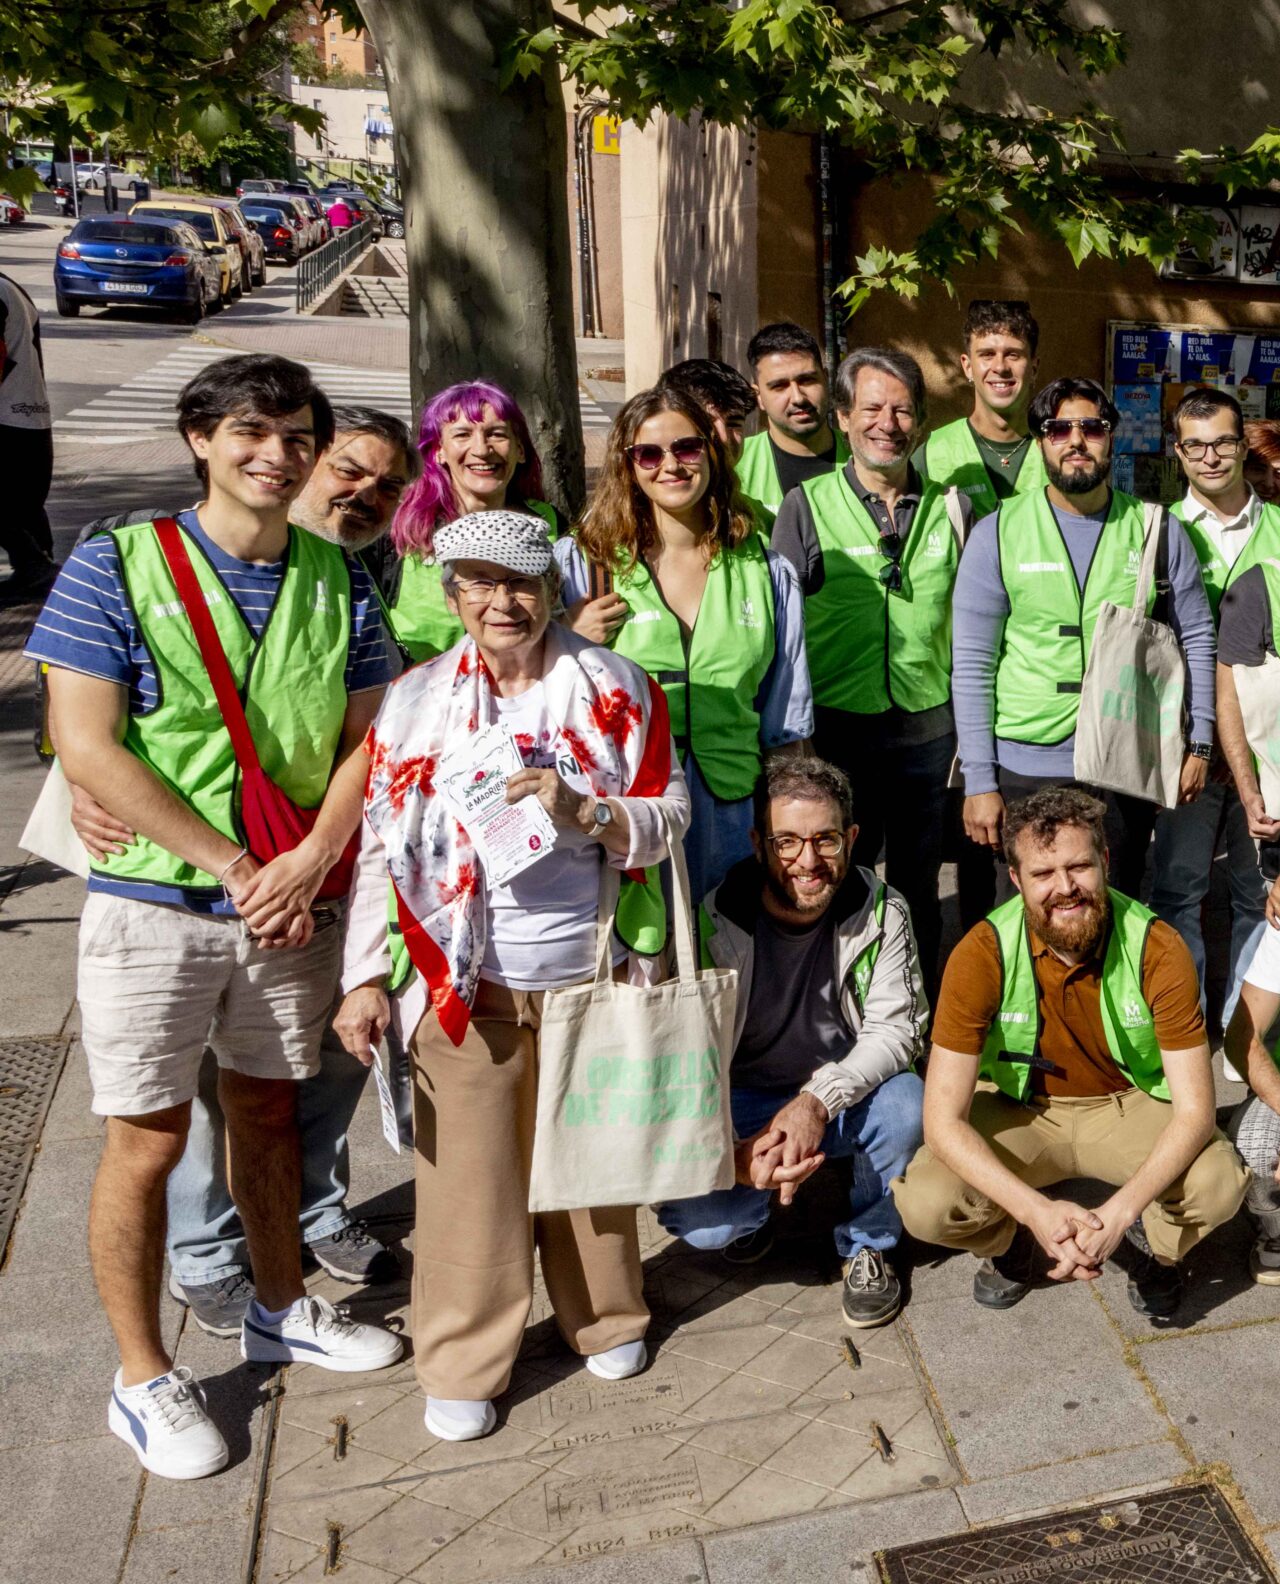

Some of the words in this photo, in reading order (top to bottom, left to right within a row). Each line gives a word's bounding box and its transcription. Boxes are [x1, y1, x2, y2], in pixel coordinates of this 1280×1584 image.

[1122, 335, 1134, 343] RED
[1135, 335, 1149, 343] BULL
[1188, 337, 1199, 346] RED
[1200, 338, 1213, 346] BULL
[1122, 344, 1131, 352] TE
[1261, 340, 1272, 349] RED
[1195, 346, 1204, 354] DA
[1260, 348, 1269, 356] TE
[1124, 392, 1151, 400] BEZOYA
[465, 801, 474, 812] LA
[587, 1046, 721, 1091] ORGULLO
[564, 1092, 605, 1128] DE
[608, 1083, 721, 1126] PUEBLO
[1060, 1538, 1172, 1568] ALUMBRADO
